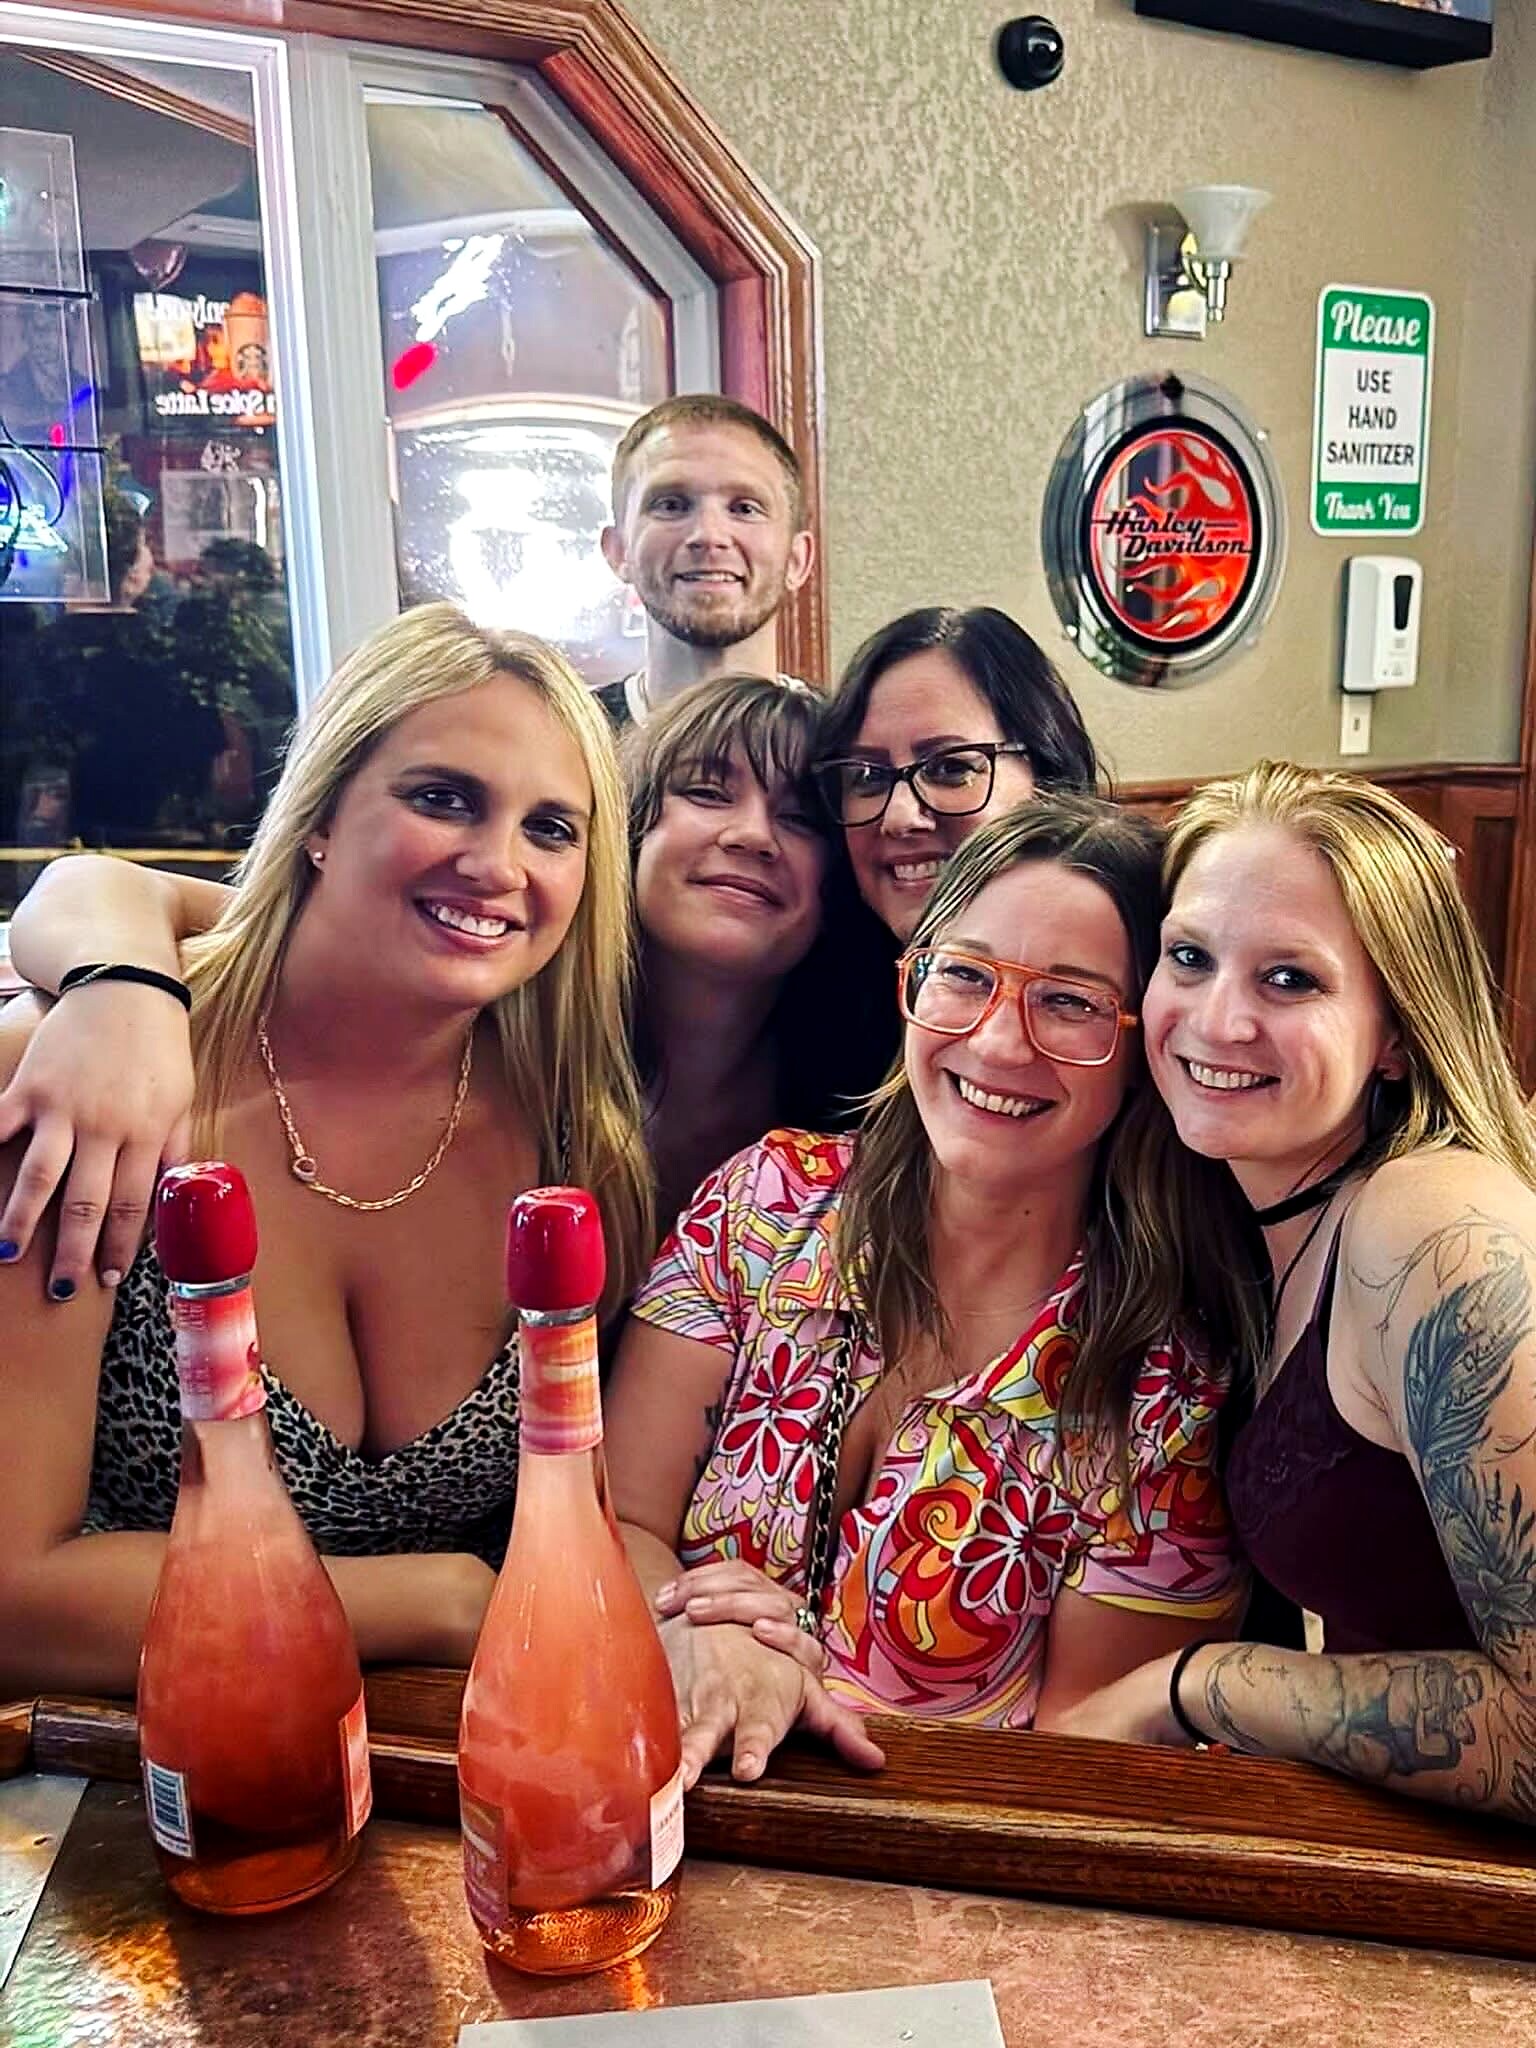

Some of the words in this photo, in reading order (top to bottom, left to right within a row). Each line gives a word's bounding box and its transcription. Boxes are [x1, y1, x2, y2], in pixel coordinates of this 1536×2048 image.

[1330, 300, 1421, 347] Please
[1357, 369, 1392, 394] USE
[1348, 405, 1397, 429] HAND
[1326, 441, 1414, 466] SANITIZER
[1324, 491, 1376, 520] Thank
[1378, 492, 1411, 520] You
[1103, 511, 1208, 542] Harley
[1124, 534, 1249, 558] Davidson
